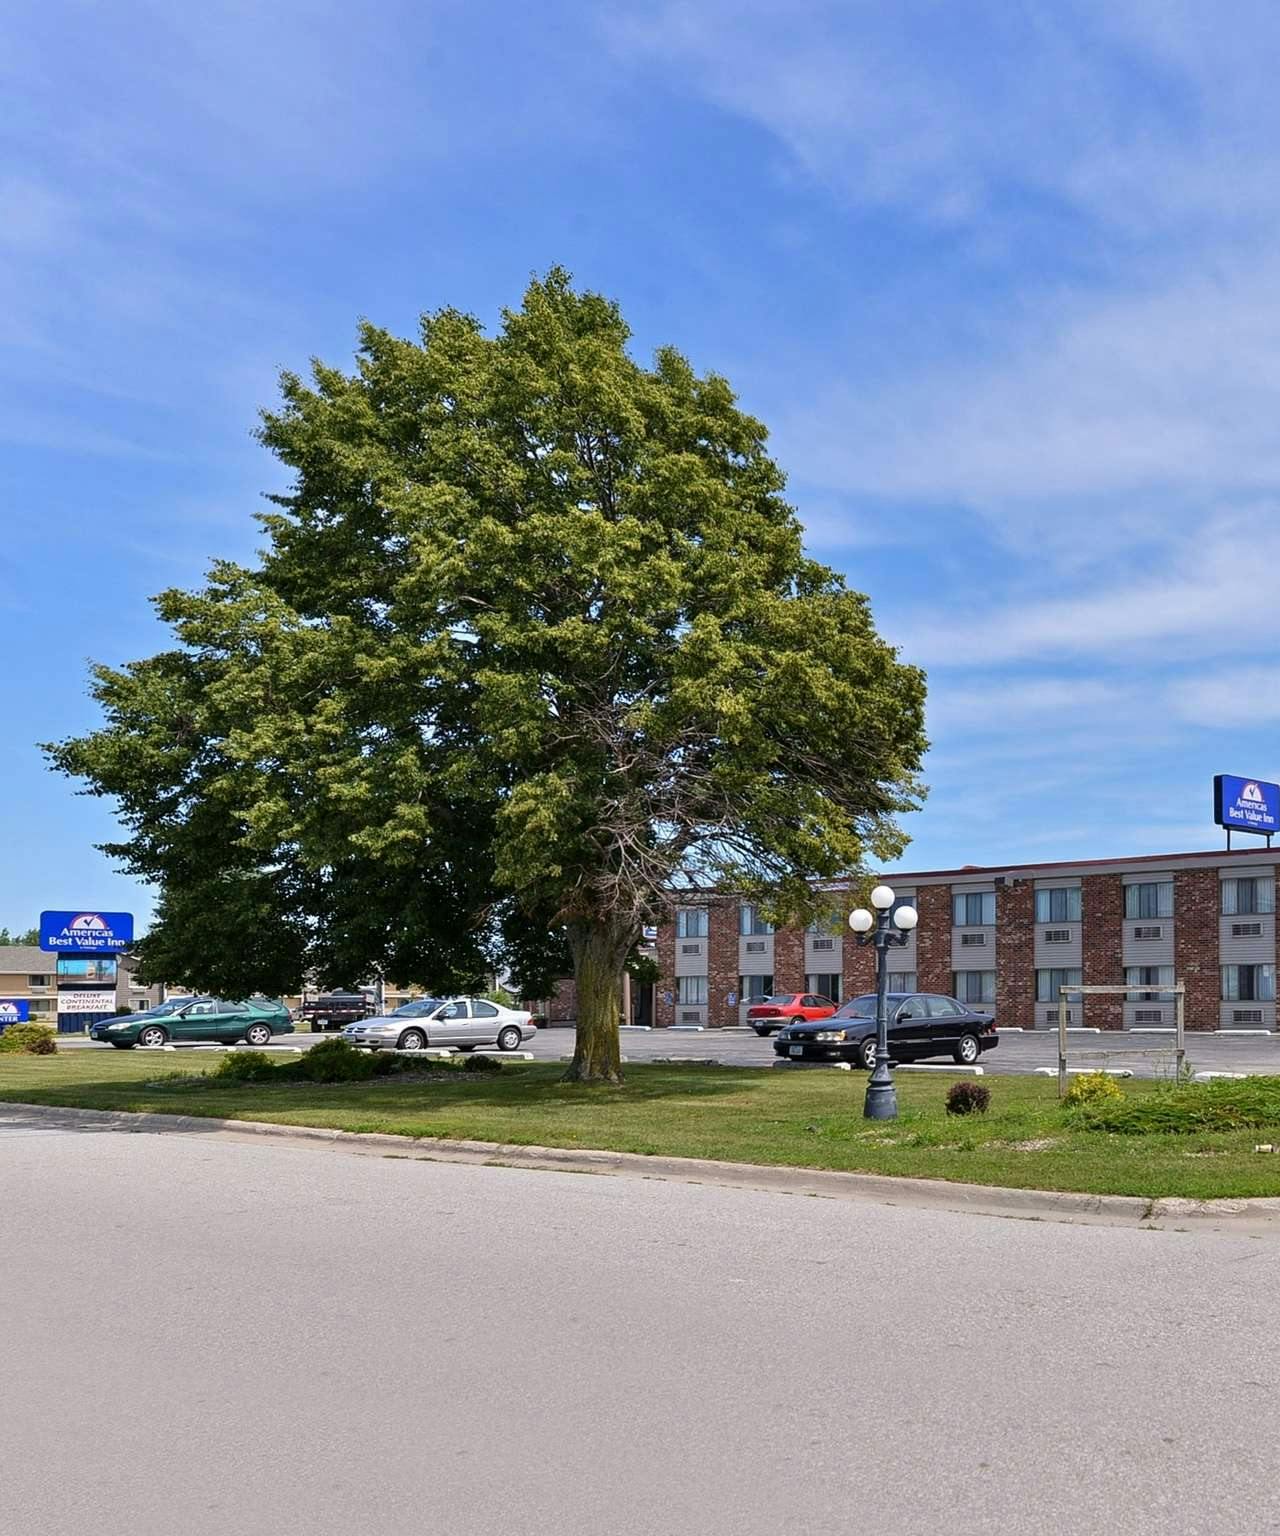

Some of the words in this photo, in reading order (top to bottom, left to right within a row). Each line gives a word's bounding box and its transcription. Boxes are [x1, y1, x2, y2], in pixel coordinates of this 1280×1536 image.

[1236, 797, 1267, 812] Americas
[1229, 807, 1244, 819] Best
[1244, 809, 1263, 822] Value
[1263, 813, 1274, 824] Inn
[60, 927, 114, 937] Americas
[48, 936, 73, 946] Best
[74, 937, 105, 946] Value
[107, 938, 125, 946] Inn
